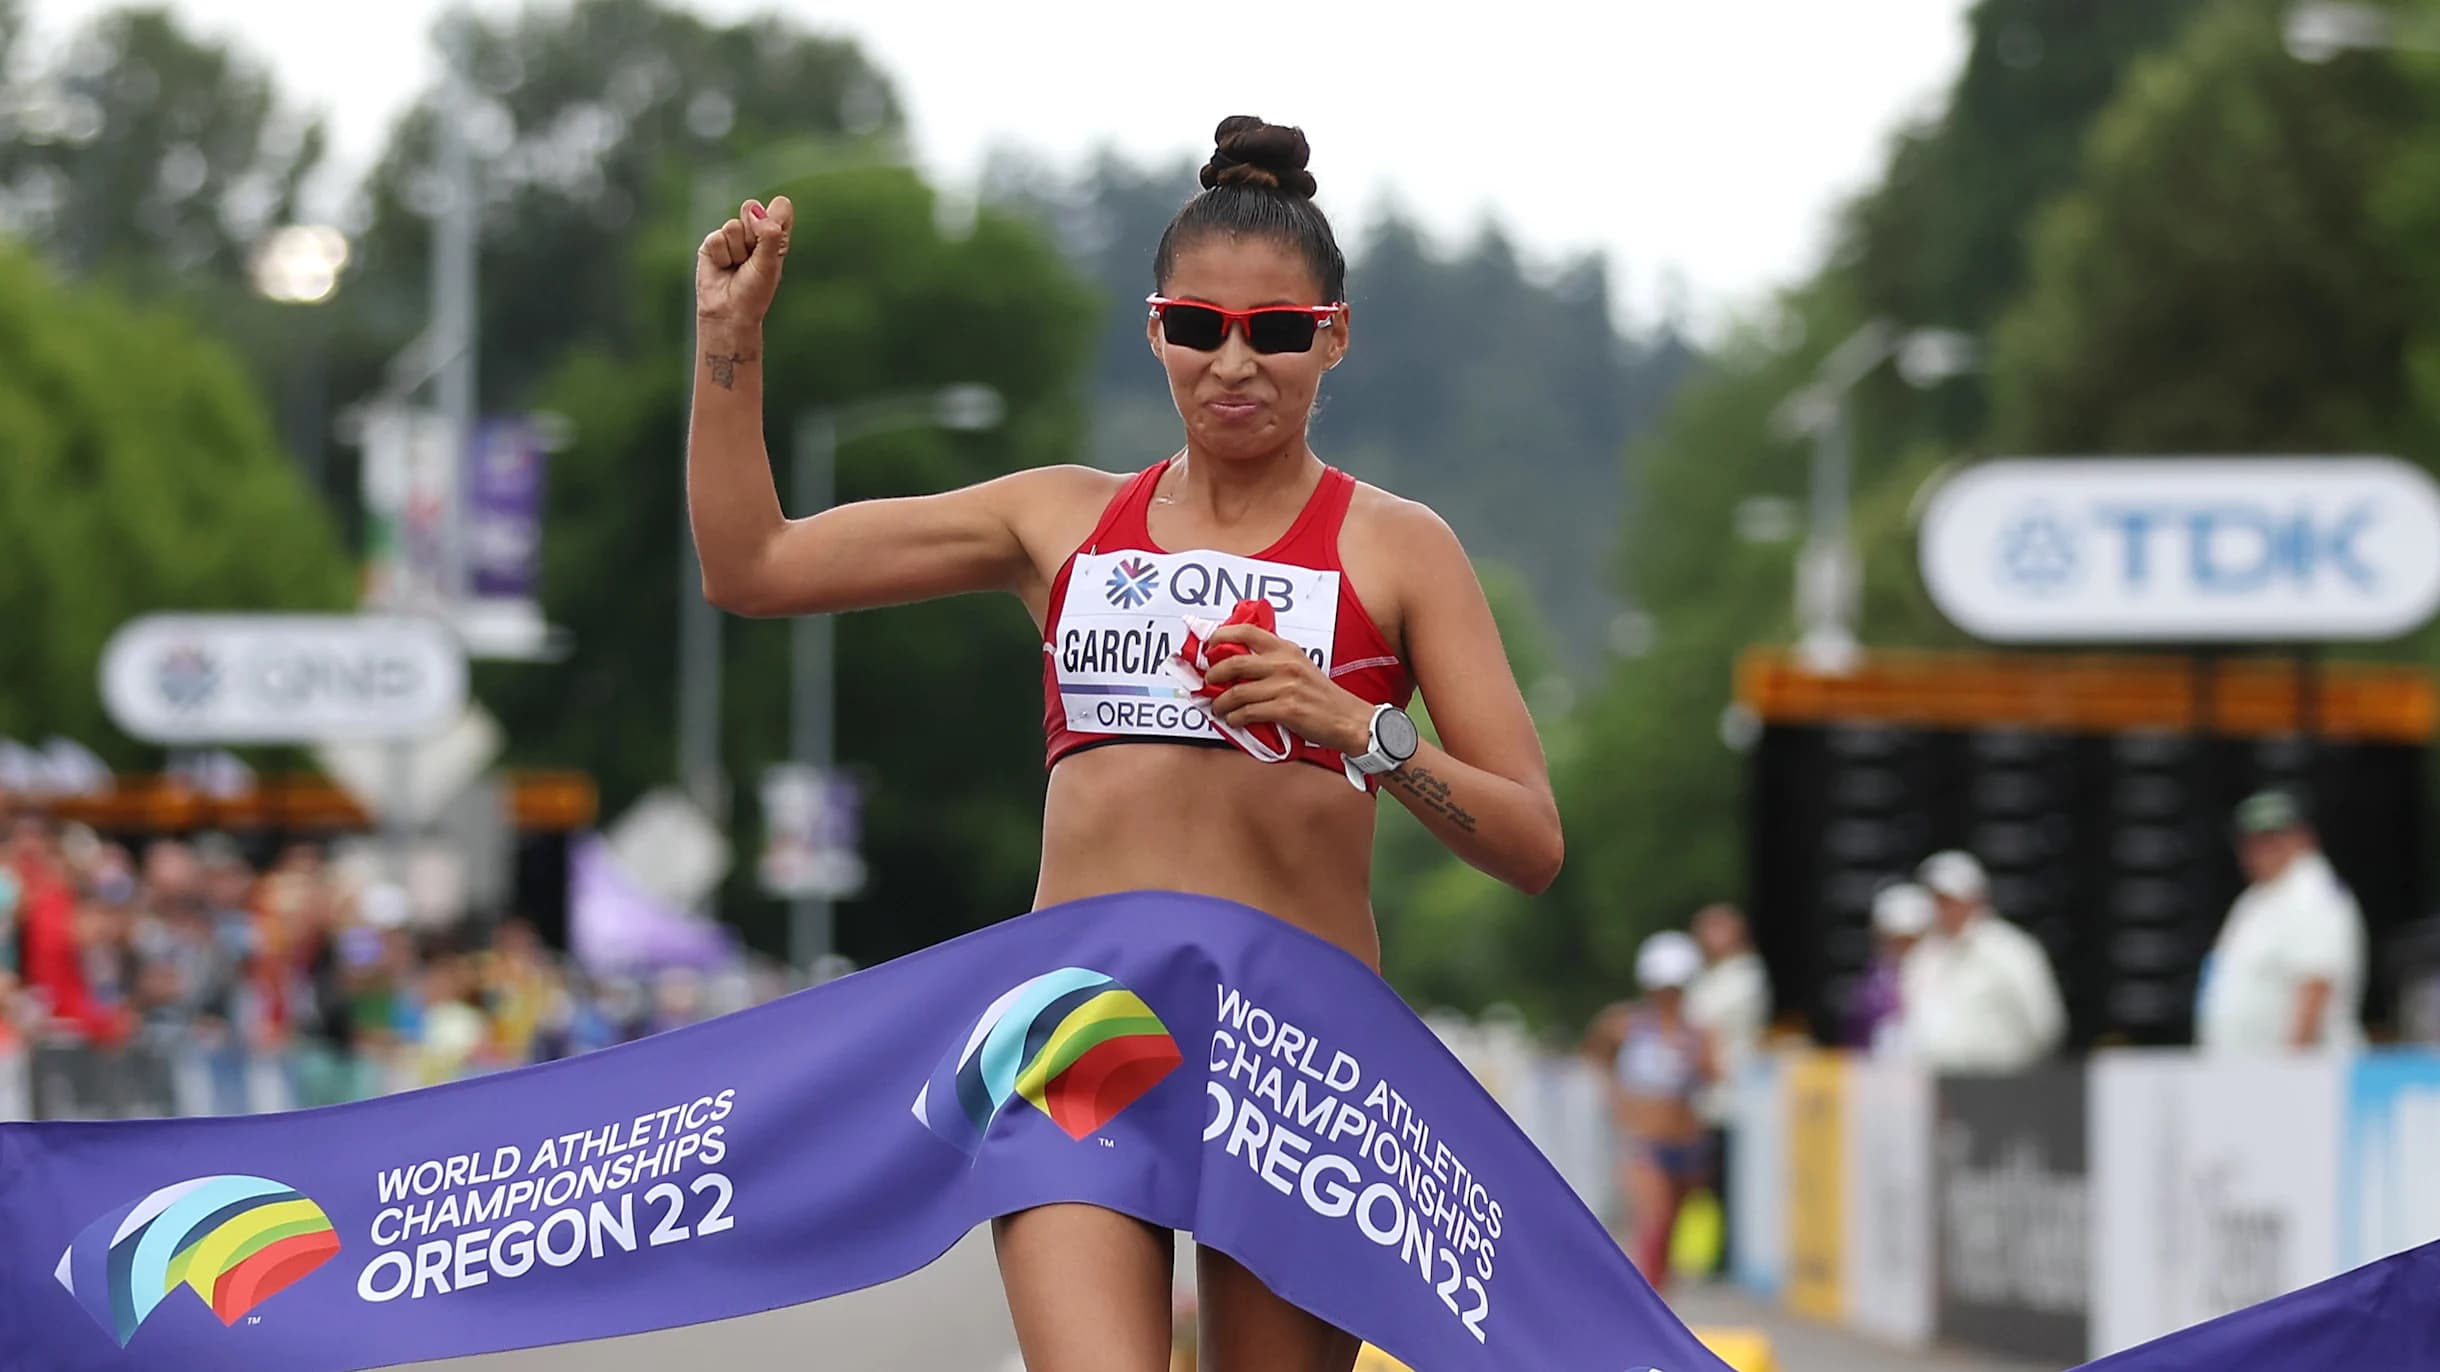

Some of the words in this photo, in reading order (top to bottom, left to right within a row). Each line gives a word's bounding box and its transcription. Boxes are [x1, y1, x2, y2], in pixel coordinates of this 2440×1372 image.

[1169, 563, 1295, 613] QNB
[2094, 503, 2378, 592] TDK
[1062, 620, 1171, 676] GARCÍA
[1096, 701, 1213, 732] OREGO
[377, 1145, 521, 1204] WORLD
[528, 1088, 736, 1175] ATHLETICS
[1209, 1029, 1495, 1281] CHAMPIONSHIPS
[1217, 983, 1361, 1092] WORLD
[1363, 1079, 1503, 1239] ATHLETICS
[370, 1125, 727, 1247] CHAMPIONSHIPS
